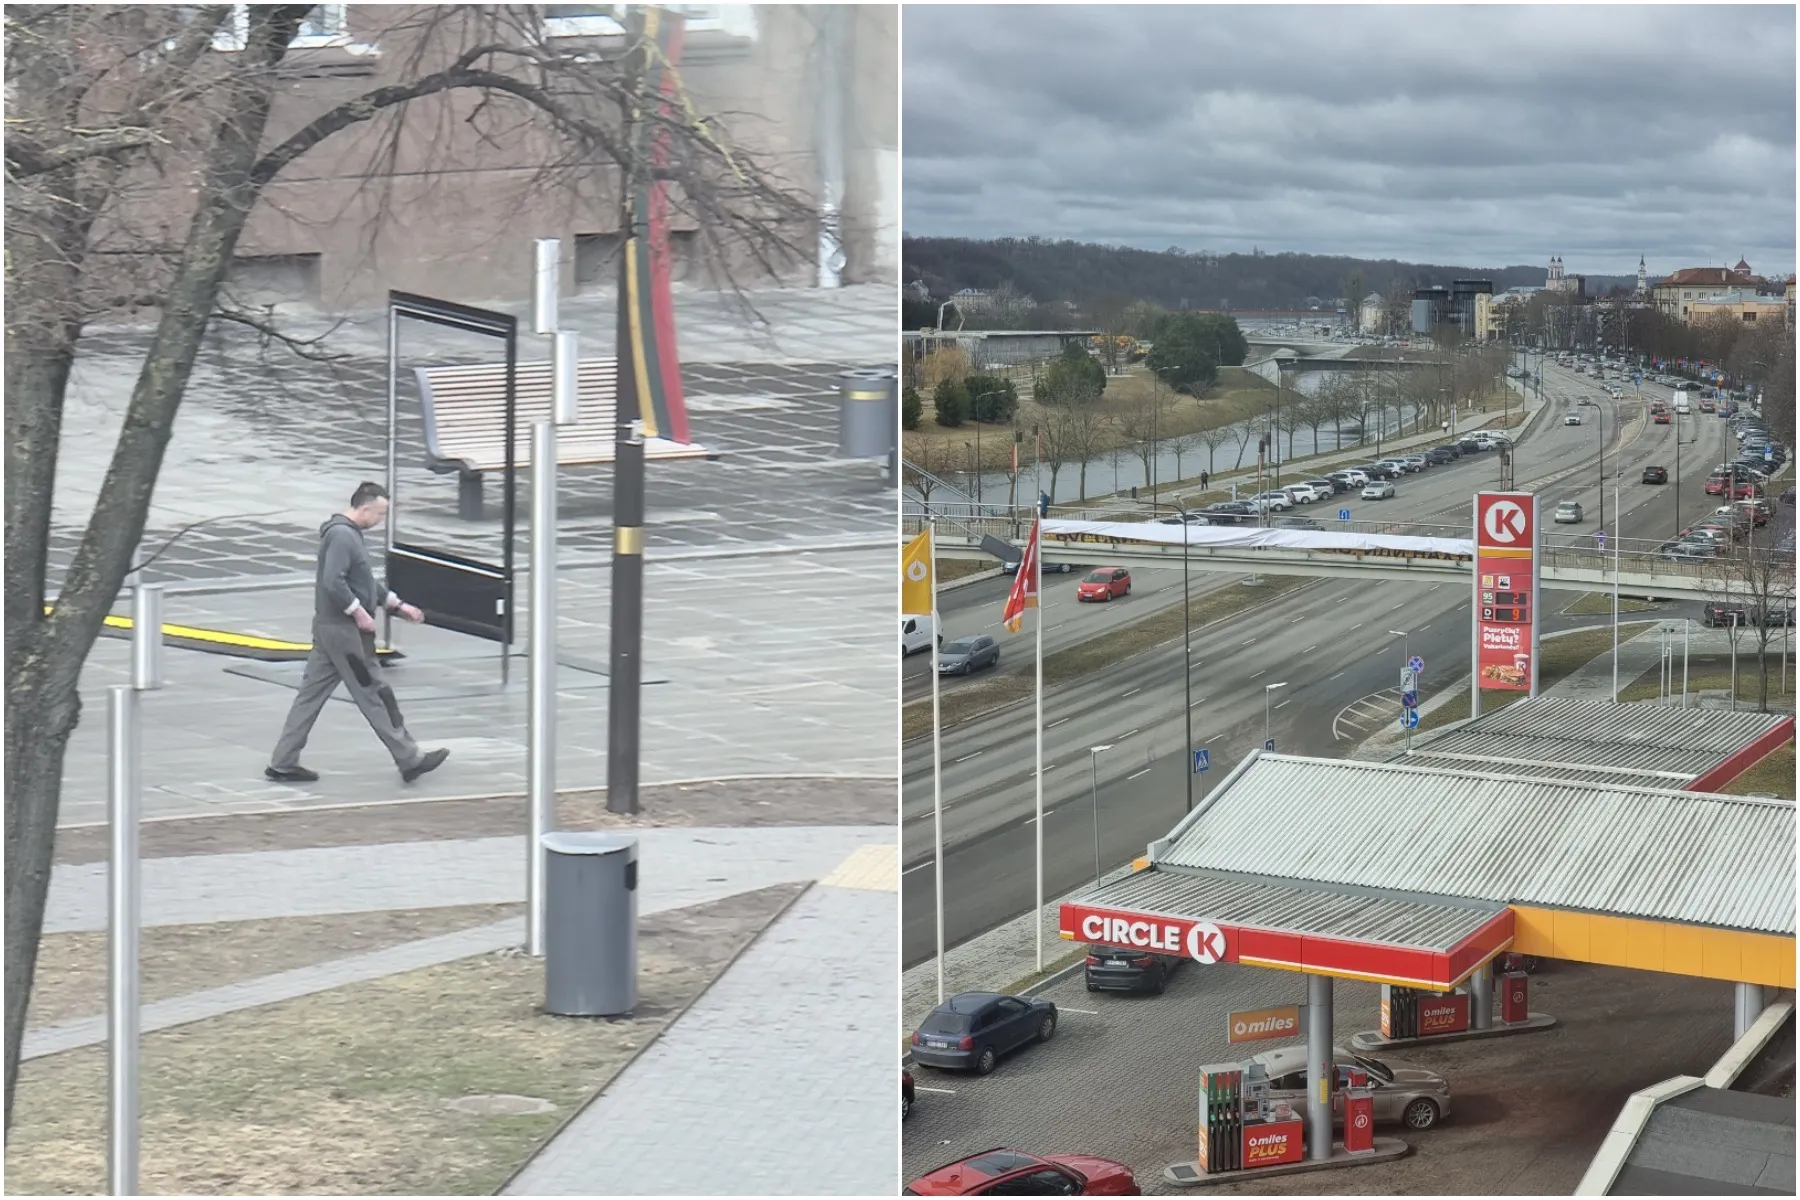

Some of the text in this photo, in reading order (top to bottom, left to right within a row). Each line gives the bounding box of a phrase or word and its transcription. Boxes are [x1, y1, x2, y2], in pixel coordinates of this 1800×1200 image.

[1495, 508, 1524, 540] K
[1483, 592, 1493, 600] 95
[1484, 608, 1492, 616] D
[1512, 608, 1520, 621] 9
[1082, 915, 1220, 962] CIRCLE K
[1431, 1006, 1456, 1016] miles
[1248, 1016, 1294, 1034] miles
[1424, 1014, 1456, 1026] PLUS
[1258, 1134, 1288, 1146] miles
[1249, 1143, 1288, 1158] PLUS
